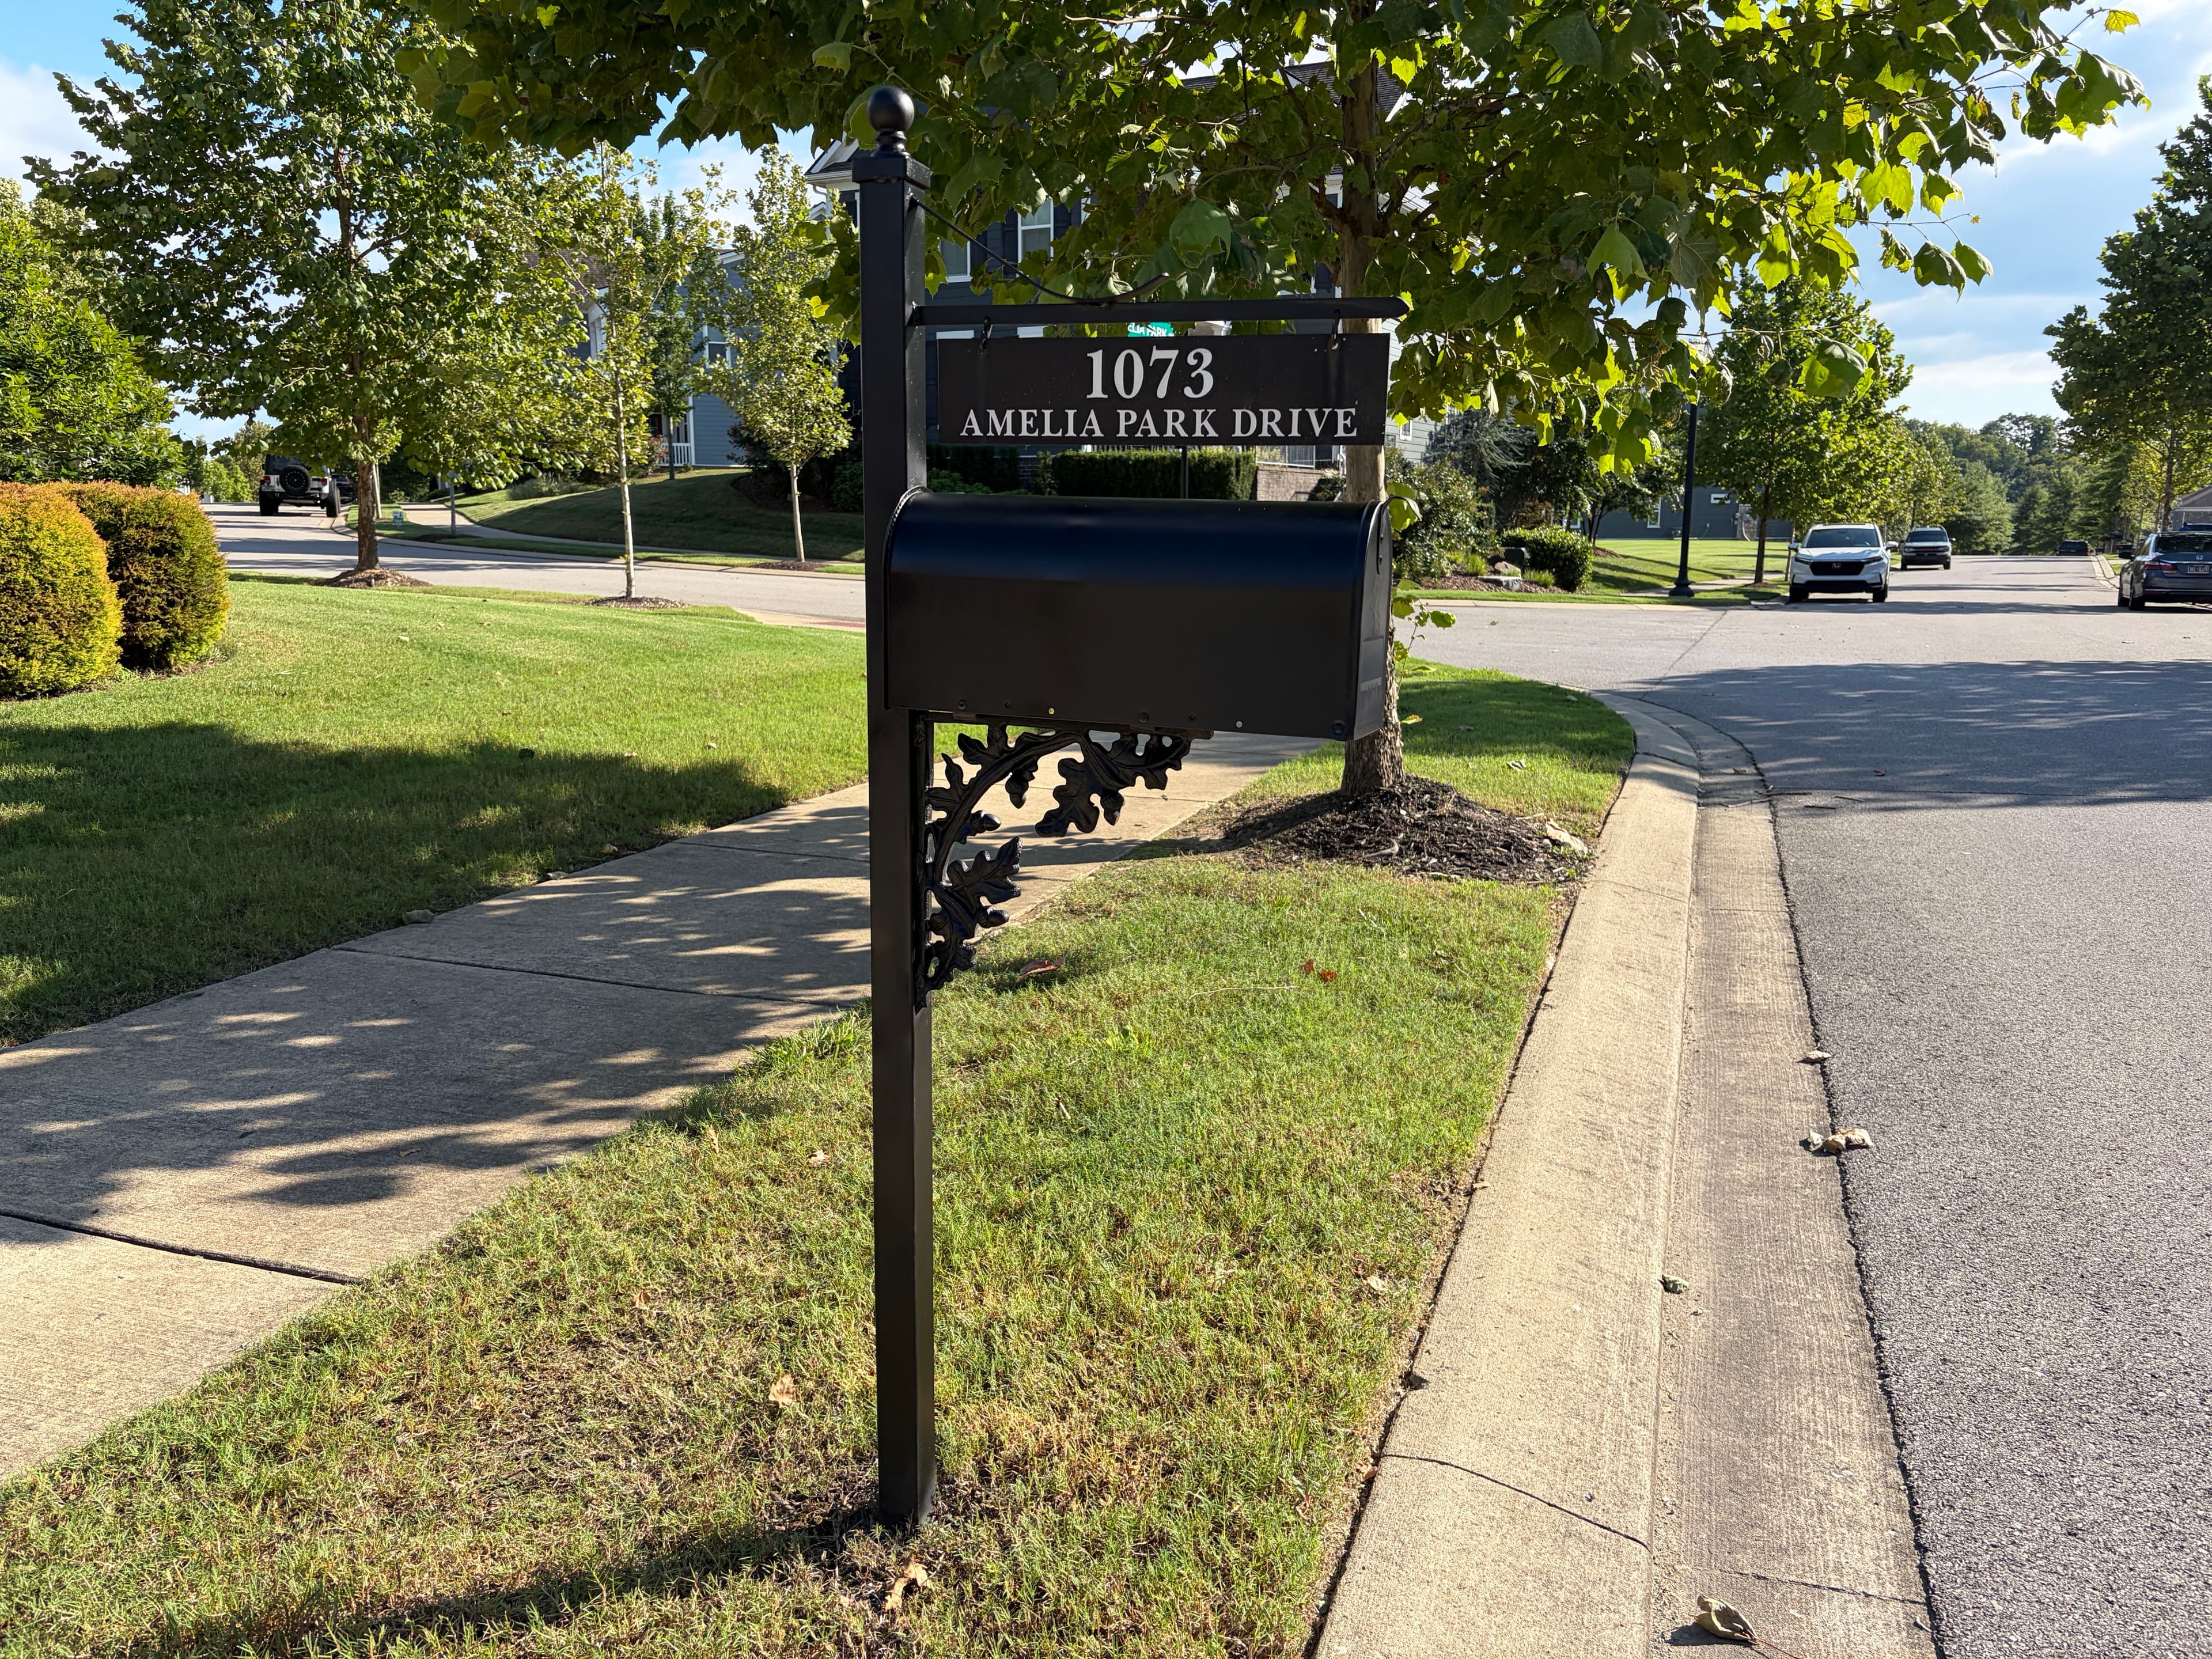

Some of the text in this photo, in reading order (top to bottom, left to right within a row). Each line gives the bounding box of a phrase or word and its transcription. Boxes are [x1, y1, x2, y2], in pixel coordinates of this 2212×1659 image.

[1146, 325, 1167, 337] PARK
[1086, 345, 1214, 399] 1073
[960, 408, 1358, 437] AMELIA PARK DRIVE
